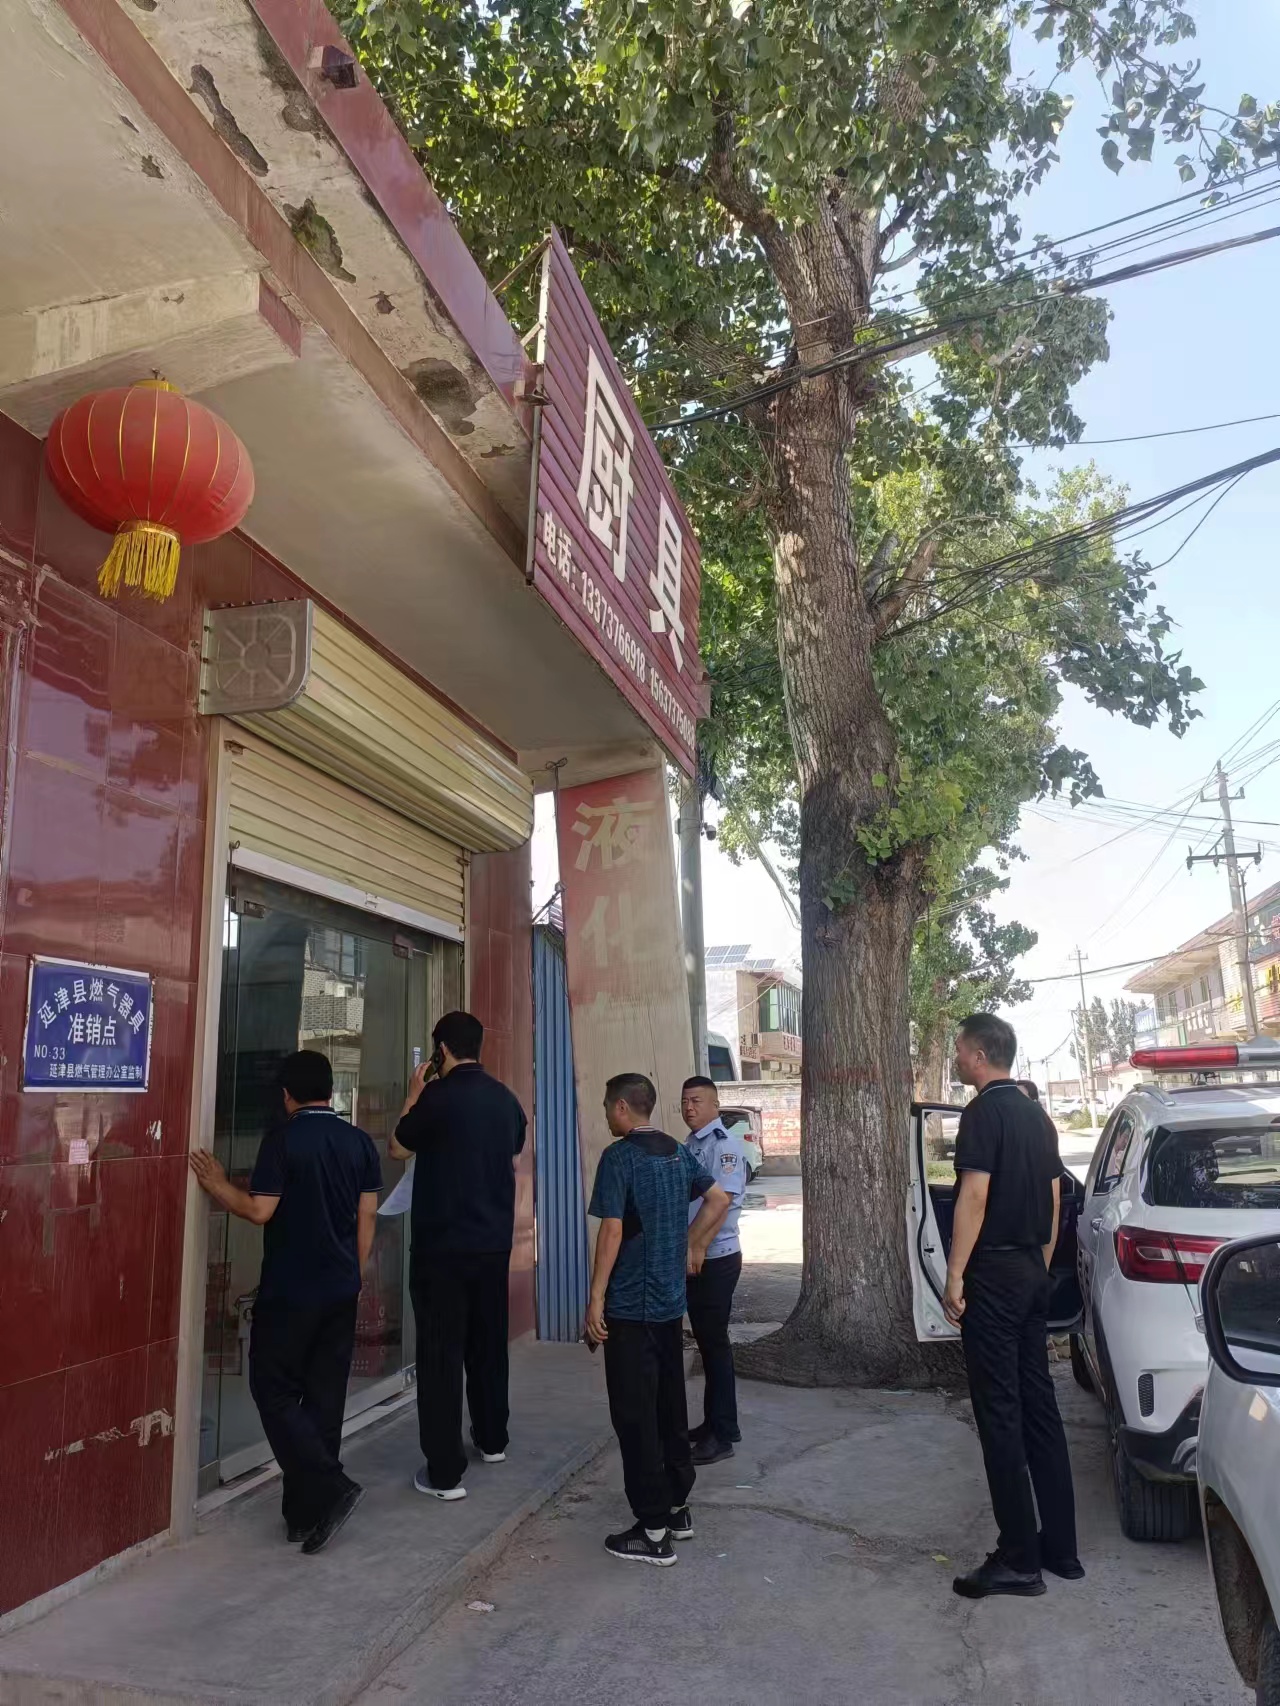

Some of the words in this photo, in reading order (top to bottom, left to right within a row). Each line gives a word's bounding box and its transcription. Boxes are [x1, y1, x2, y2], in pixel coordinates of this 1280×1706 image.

[577, 344, 685, 675] 厨具
[37, 978, 145, 1034] 延津县燃气器具
[67, 1013, 117, 1046] 准销点
[49, 1063, 143, 1080] 延津县燃气管理办公室监制
